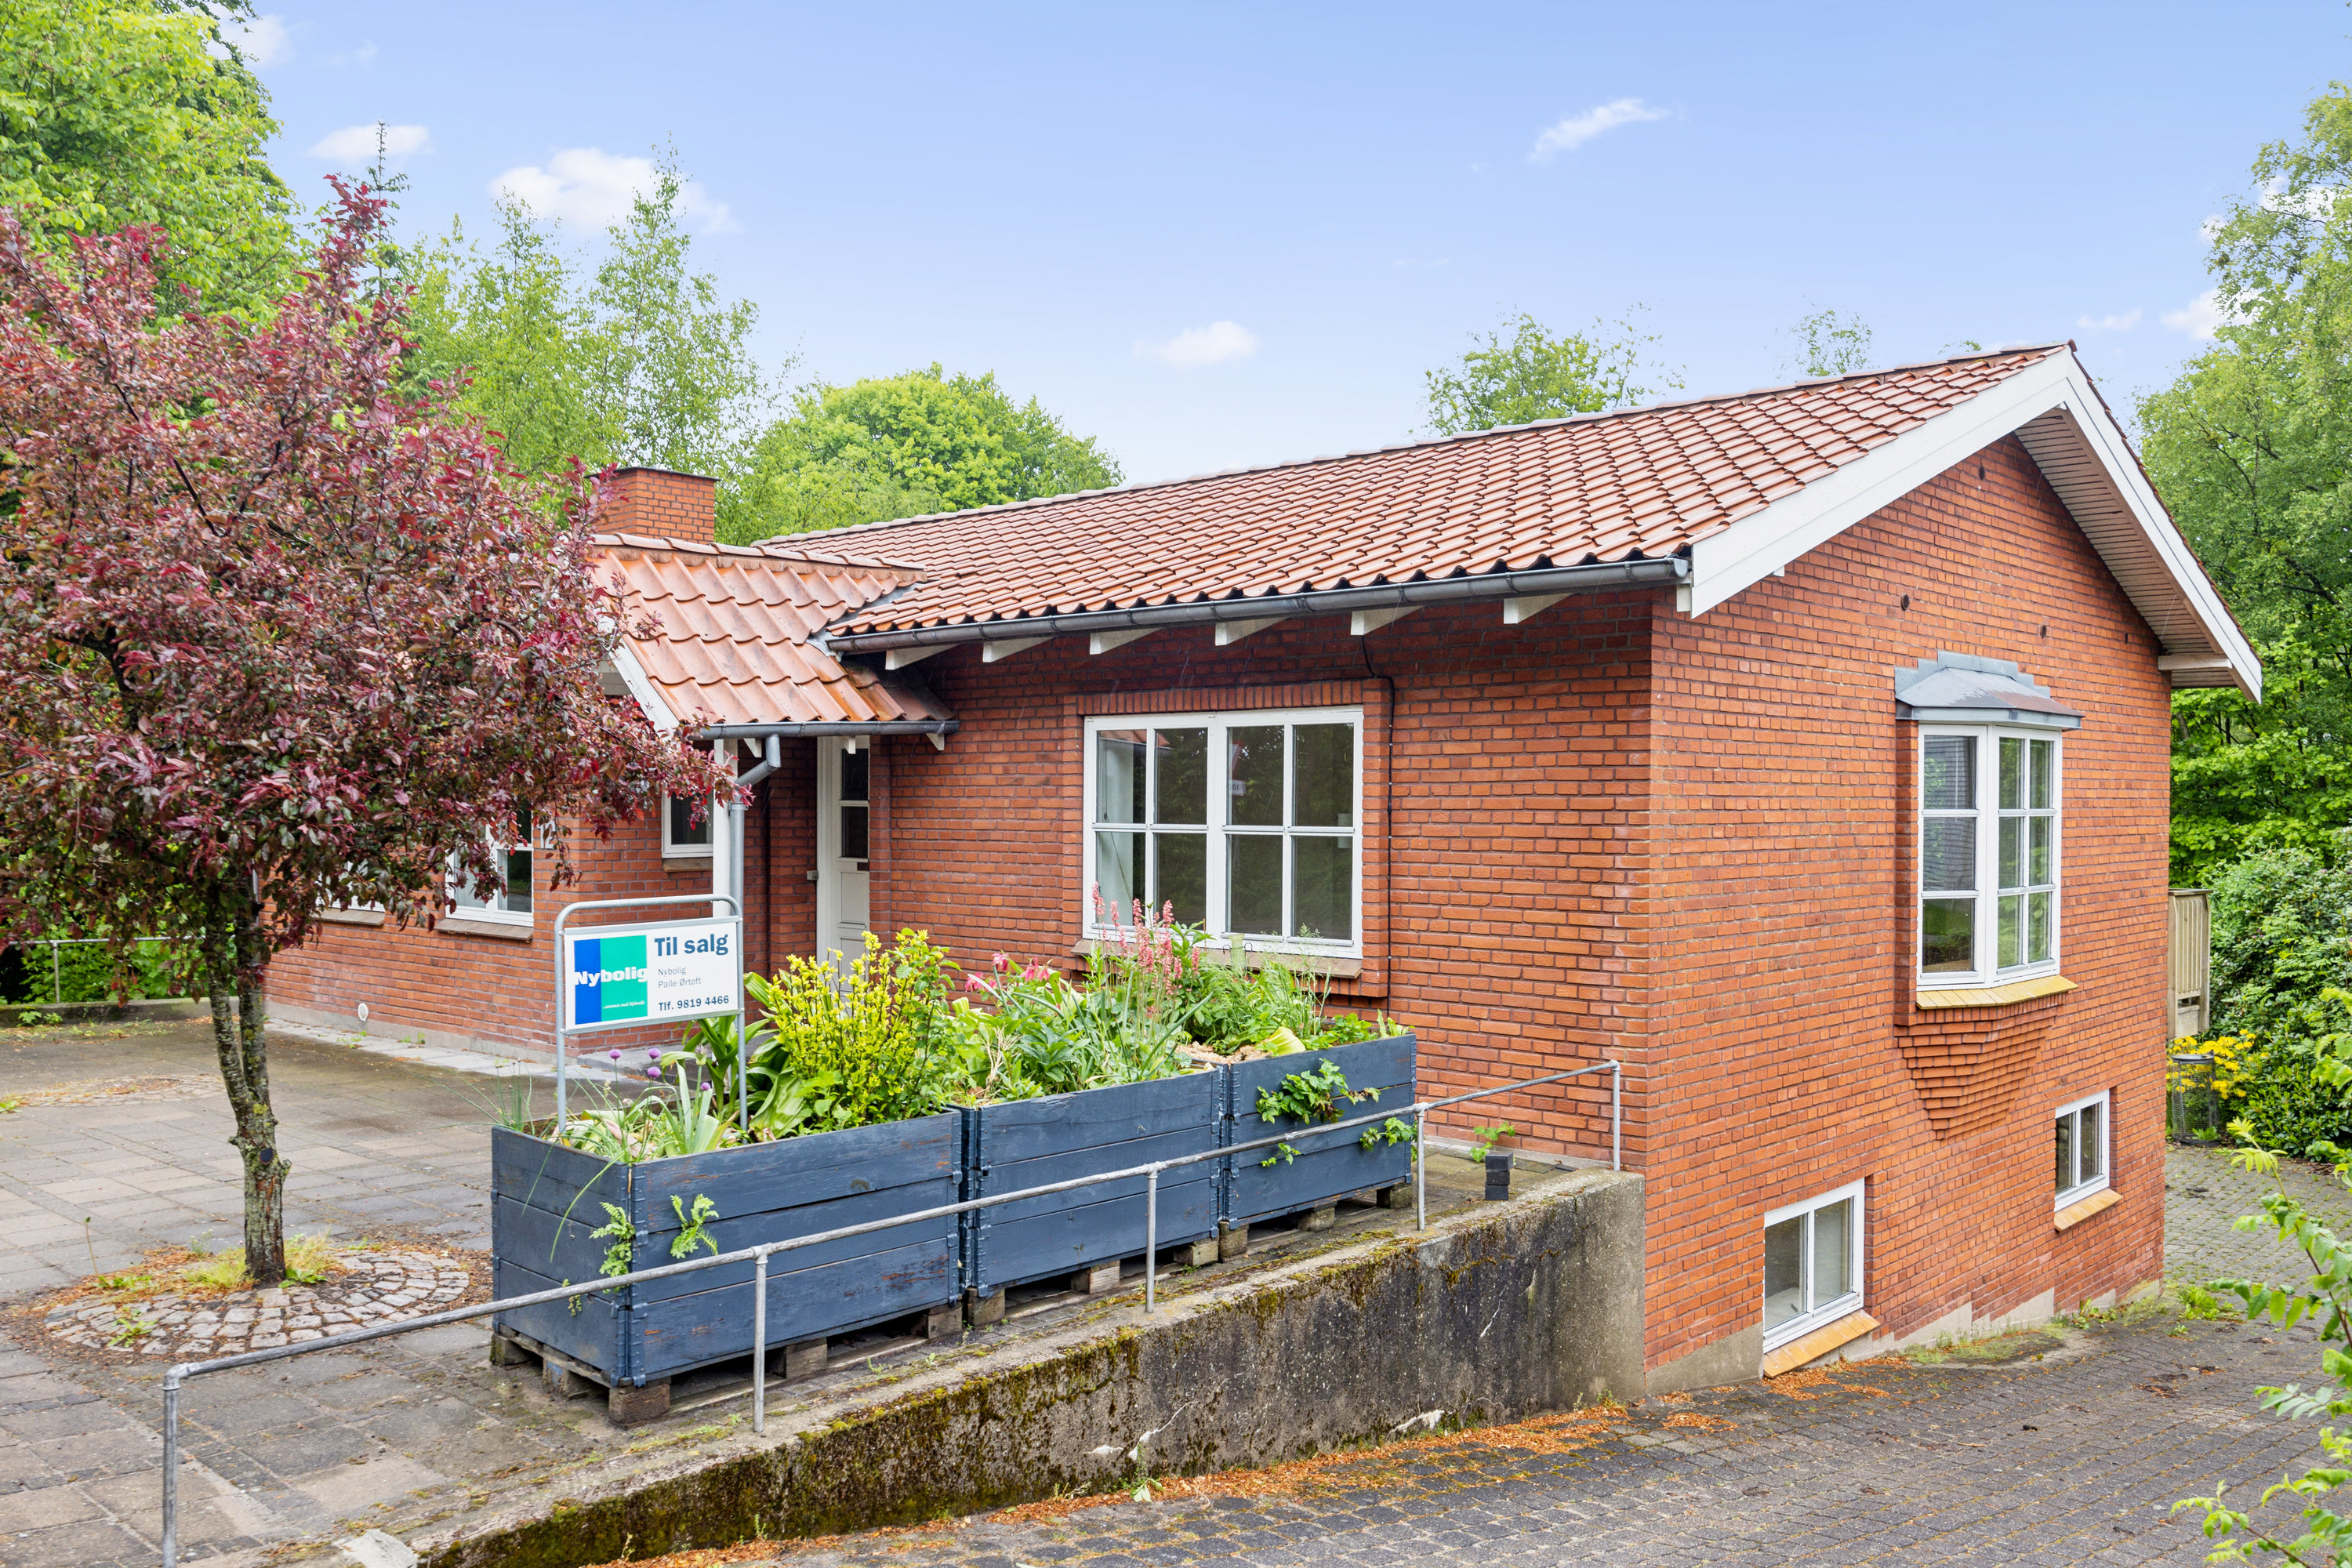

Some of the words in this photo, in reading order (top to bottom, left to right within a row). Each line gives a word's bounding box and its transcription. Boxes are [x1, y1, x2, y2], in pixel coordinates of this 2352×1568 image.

[536, 820, 556, 848] 12
[654, 936, 677, 956] Til
[684, 934, 728, 956] salg
[574, 966, 648, 987] Nybolig
[658, 967, 687, 977] Nybolig
[658, 979, 677, 988] Palle
[679, 977, 702, 986] Ørtoft
[659, 1001, 674, 1011] Tlf.
[677, 998, 702, 1009] 9819
[704, 995, 729, 1006] 4466
